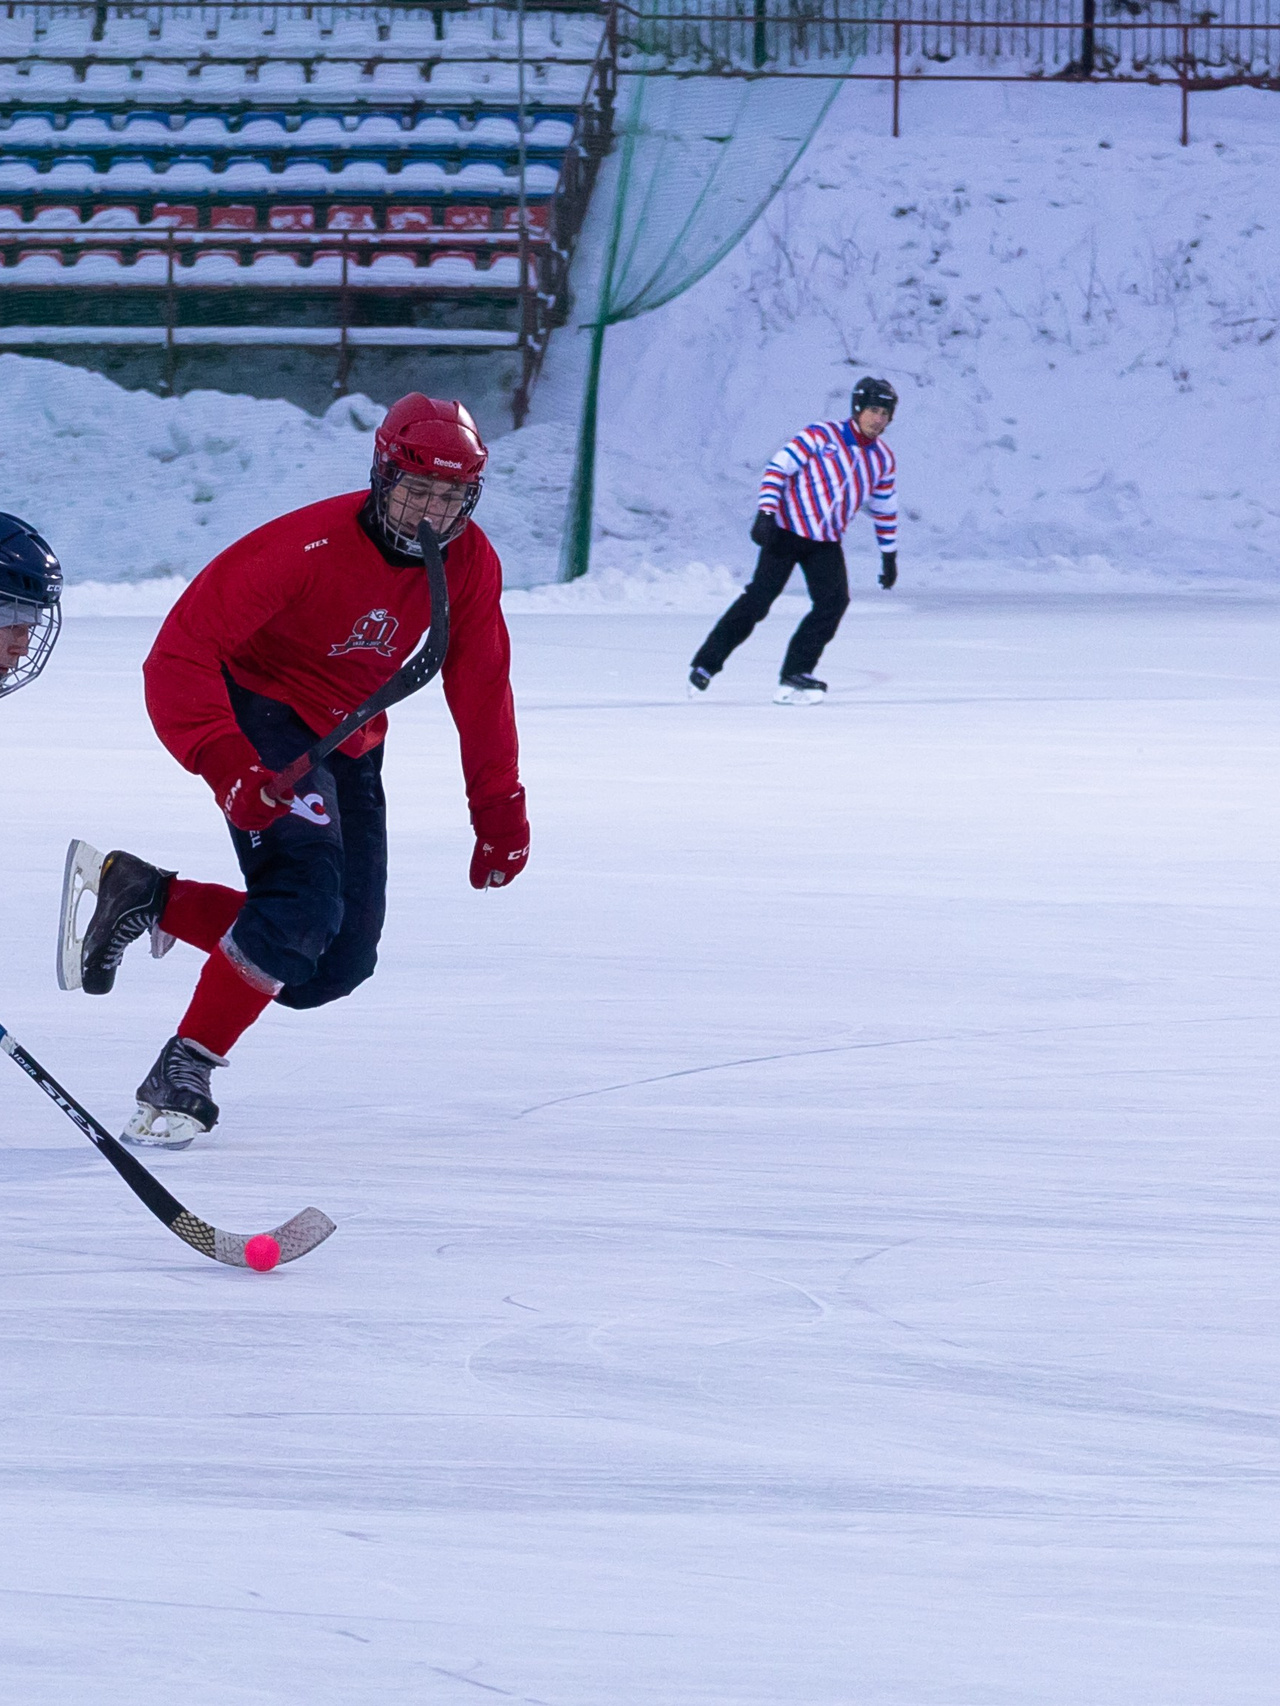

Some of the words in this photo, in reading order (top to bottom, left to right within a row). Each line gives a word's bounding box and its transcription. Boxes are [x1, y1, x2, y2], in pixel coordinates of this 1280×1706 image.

[434, 457, 462, 470] Reebok
[303, 538, 329, 552] STEX
[353, 616, 399, 645] 90
[12, 1053, 37, 1076] IDER
[39, 1079, 105, 1143] STEX
